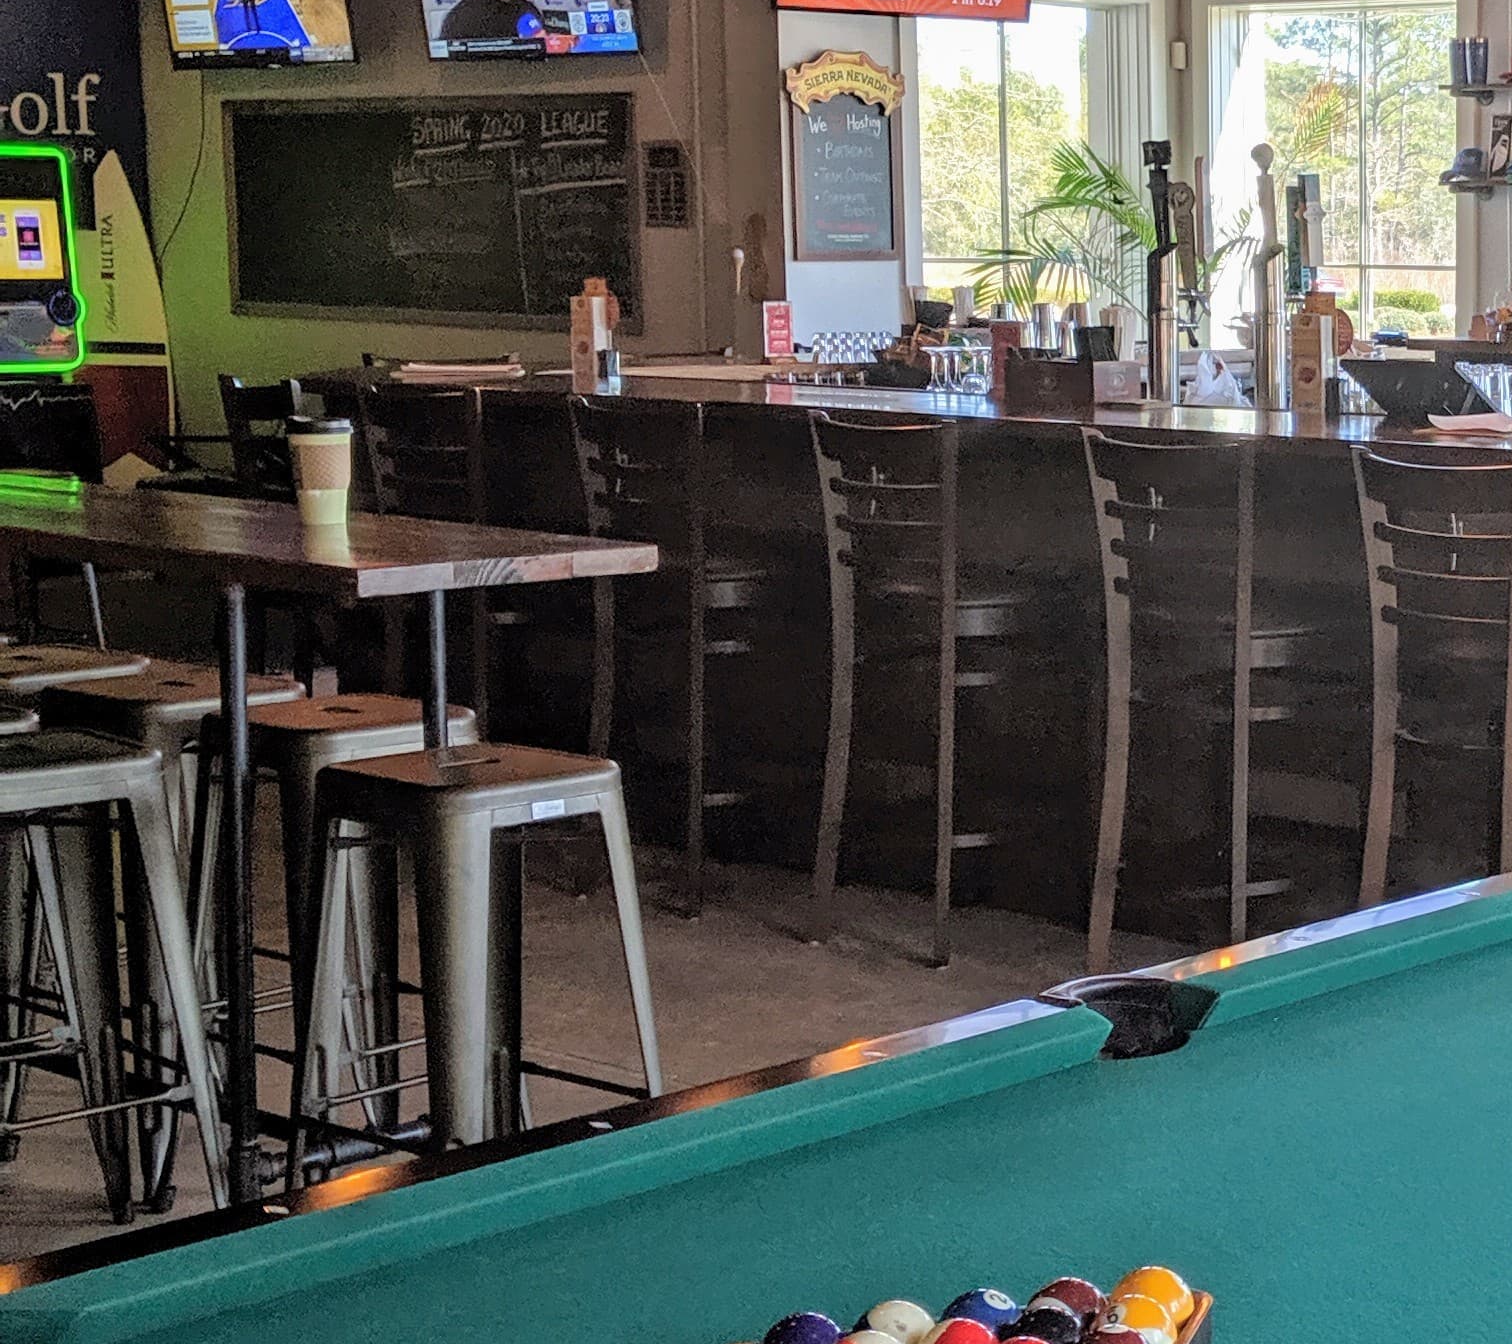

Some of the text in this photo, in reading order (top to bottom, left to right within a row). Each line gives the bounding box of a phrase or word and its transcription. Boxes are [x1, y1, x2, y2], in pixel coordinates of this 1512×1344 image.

[804, 69, 888, 94] SIERRA NEVADA
[413, 108, 609, 144] SPRING 2020 LEAGUE
[808, 114, 881, 137] We Hosting
[101, 214, 114, 270] ULTRA
